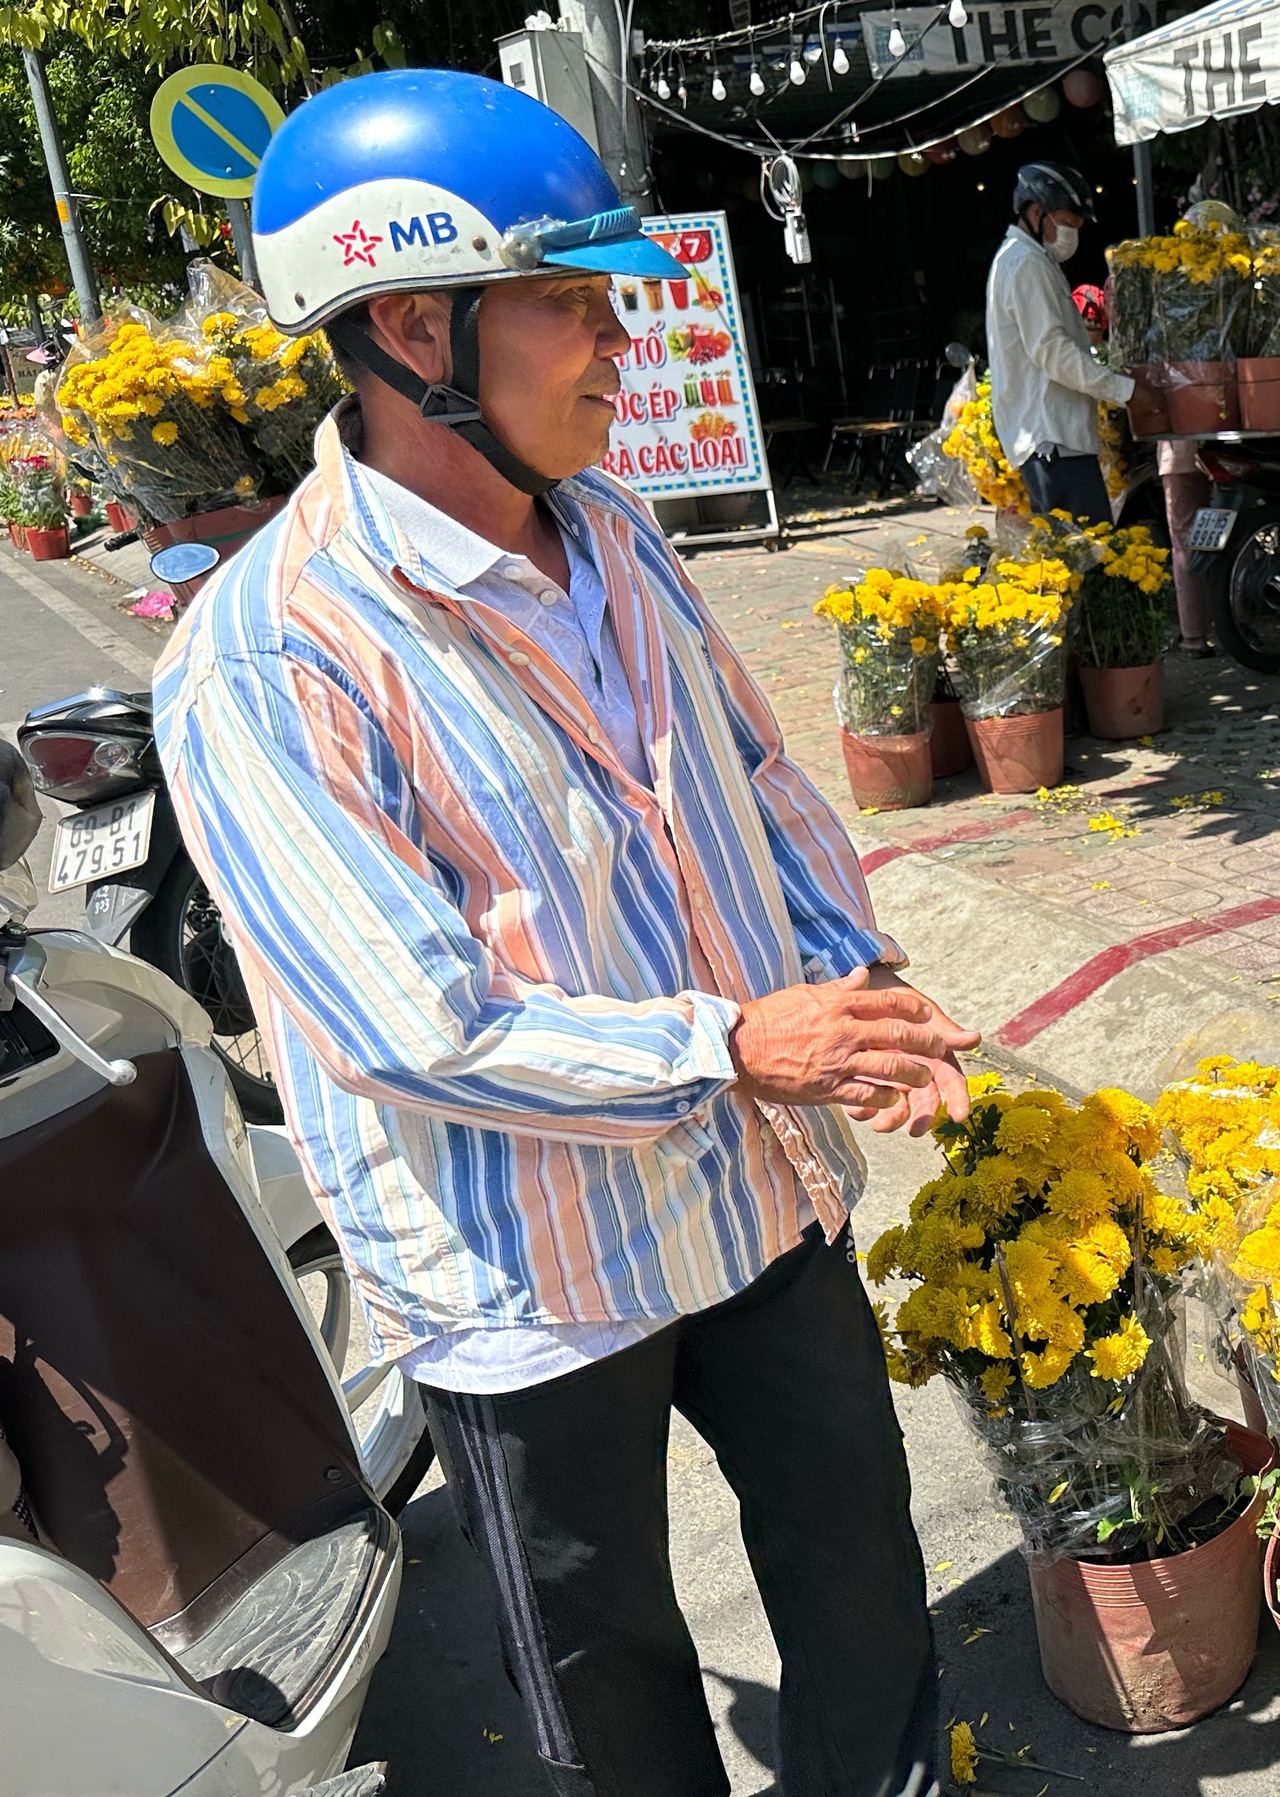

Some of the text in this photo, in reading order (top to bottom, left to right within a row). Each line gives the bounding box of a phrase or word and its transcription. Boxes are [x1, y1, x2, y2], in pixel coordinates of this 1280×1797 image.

[939, 7, 1058, 65] THE
[1174, 24, 1267, 118] THE
[388, 212, 458, 252] MB
[631, 320, 666, 367] TỐ
[649, 382, 680, 419] ÉP
[602, 435, 745, 477] RÀ CÁC LOẠI
[70, 801, 137, 849] 69-B1
[57, 831, 142, 884] 479.51
